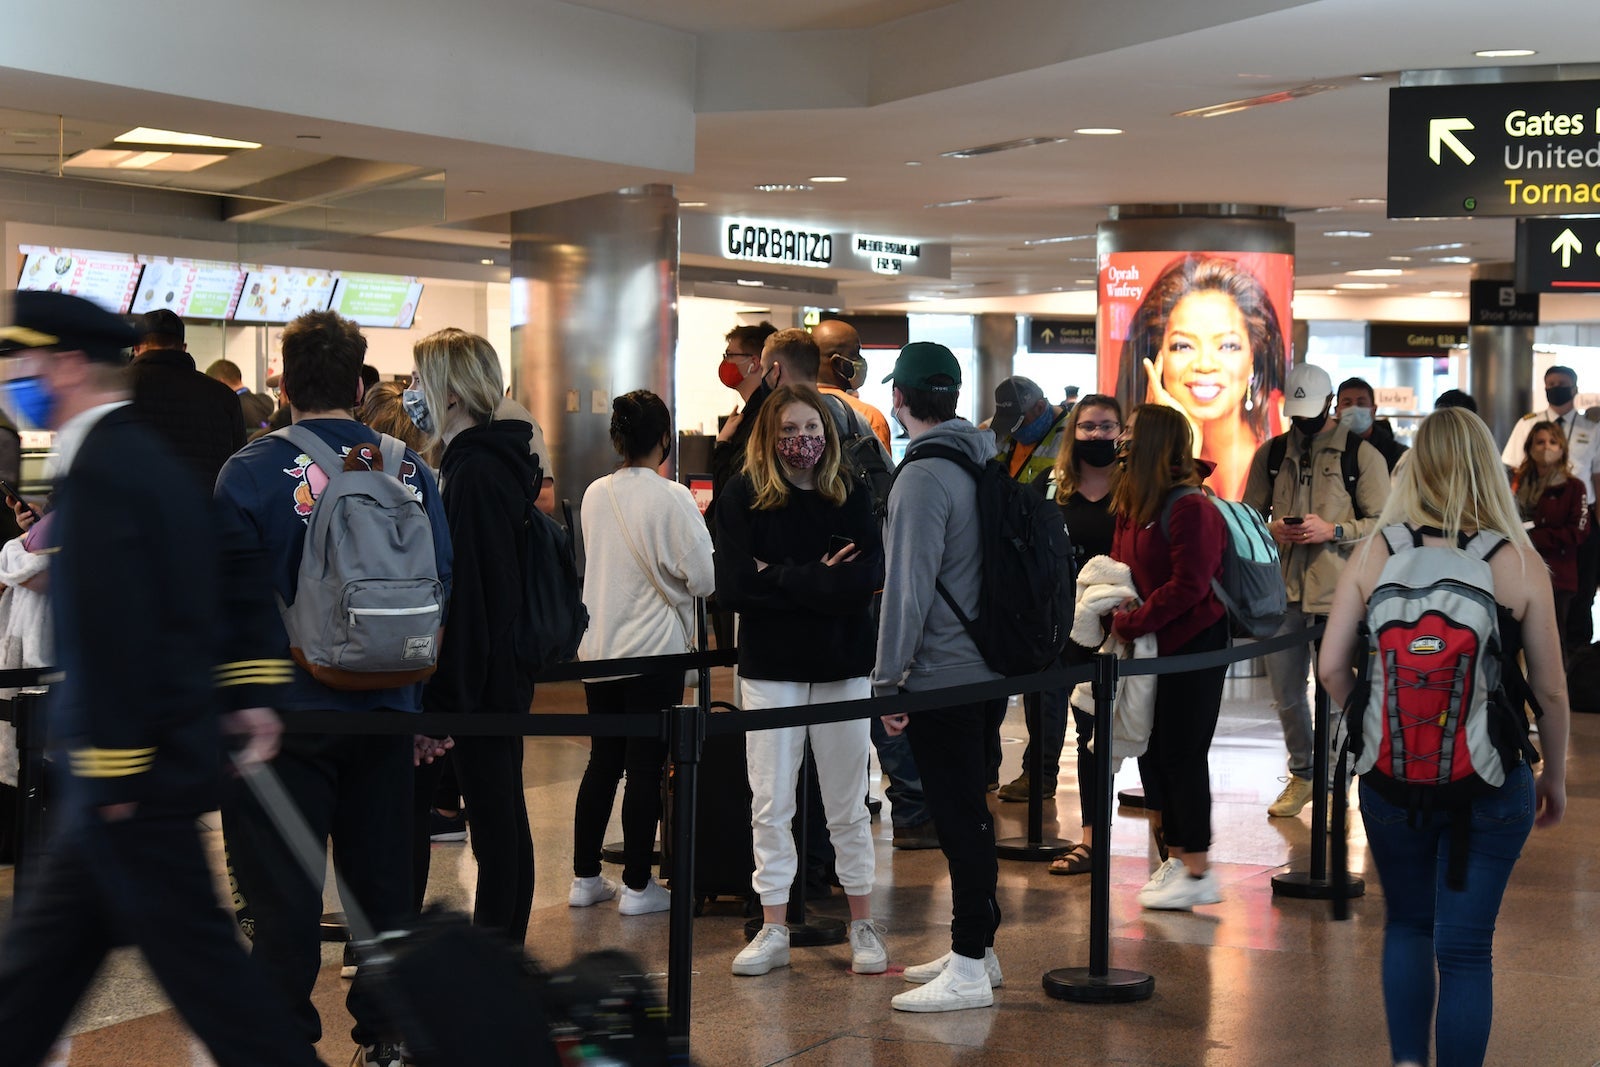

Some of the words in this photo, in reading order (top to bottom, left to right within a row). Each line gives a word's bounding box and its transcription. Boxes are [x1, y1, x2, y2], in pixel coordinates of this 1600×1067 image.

[1504, 110, 1584, 137] Gates
[1504, 142, 1600, 170] United
[728, 223, 833, 264] GARBANZO
[1108, 265, 1139, 284] Oprah
[1106, 283, 1143, 300] Winfrey
[1480, 309, 1504, 320] Shoe
[1508, 309, 1534, 320] Shine
[1060, 328, 1079, 336] Gates
[1060, 336, 1084, 344] United
[1407, 334, 1434, 346] Gates
